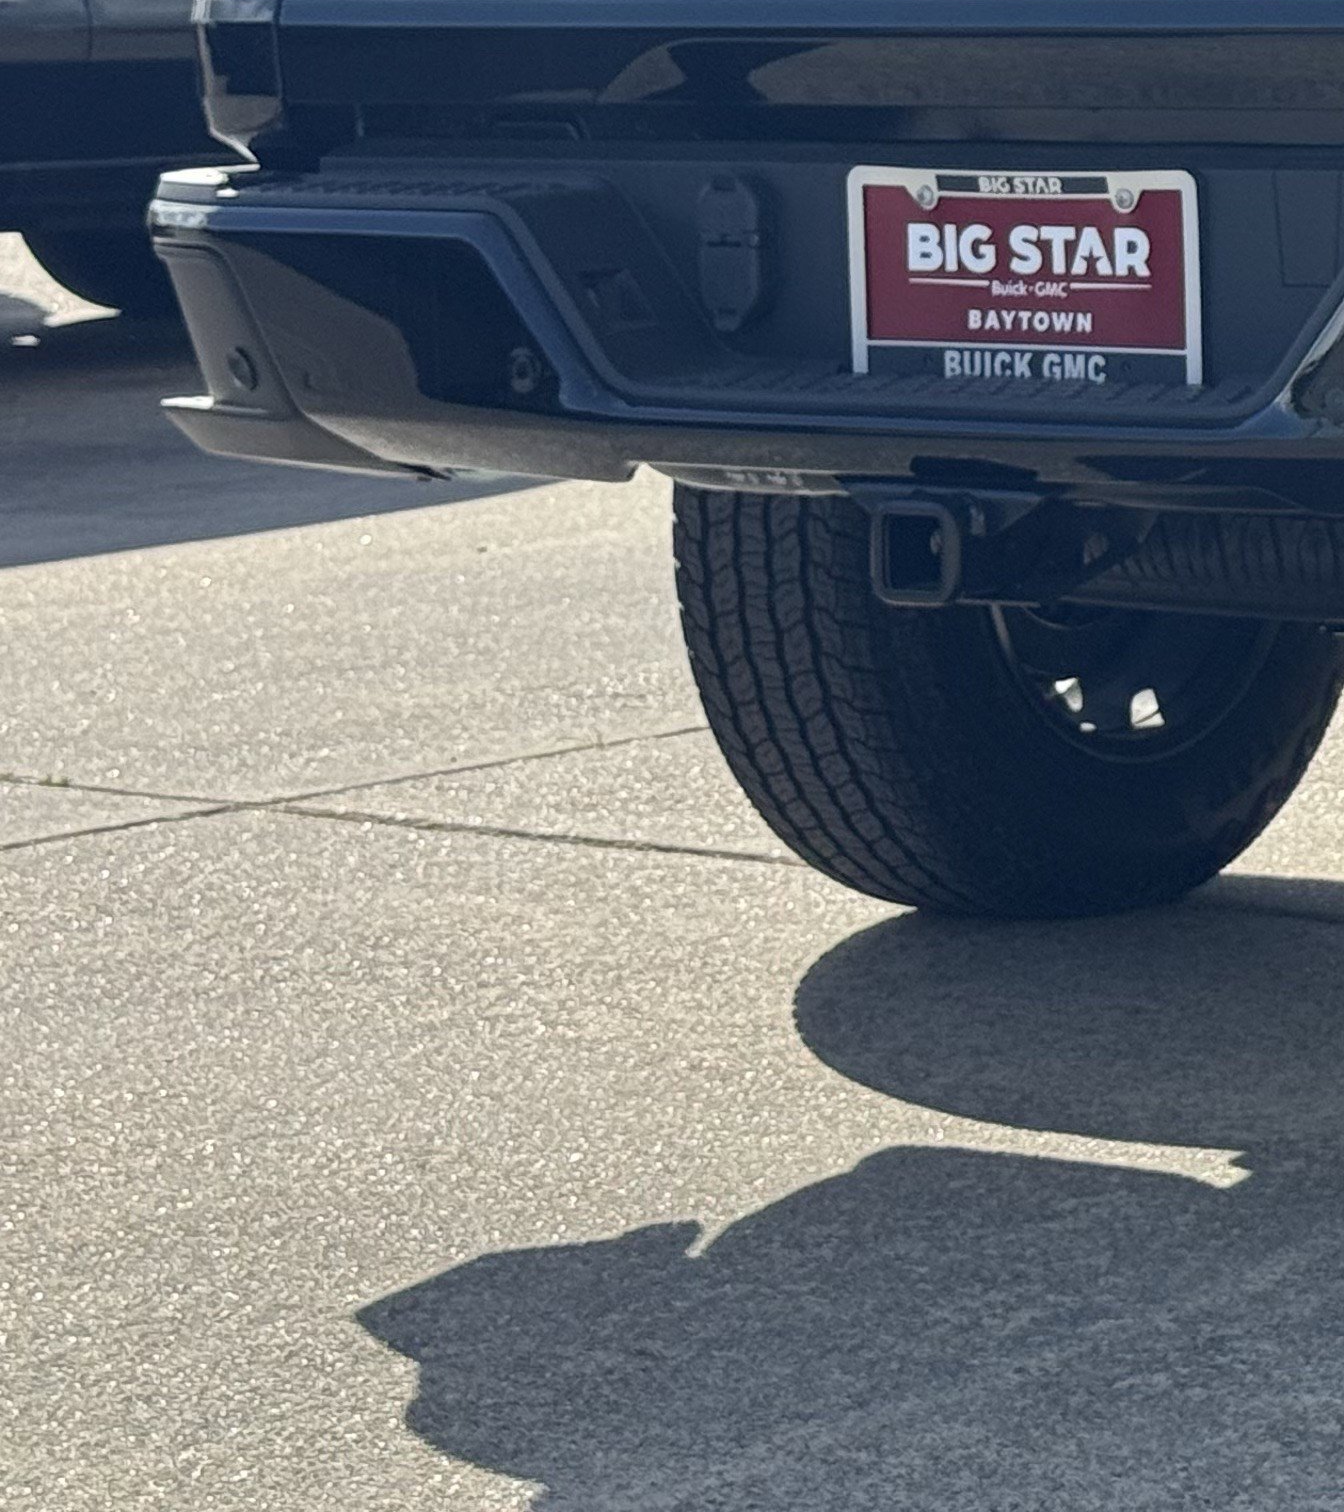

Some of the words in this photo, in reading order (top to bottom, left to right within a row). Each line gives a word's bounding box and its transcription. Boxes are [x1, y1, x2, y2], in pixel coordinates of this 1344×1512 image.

[978, 176, 1009, 193] BIG
[1014, 177, 1063, 194] STAR
[906, 222, 996, 274] BIG
[1008, 224, 1151, 277] STAR
[967, 309, 1092, 333] BAYTOWN
[944, 350, 1032, 379] BUICK
[1042, 354, 1106, 384] GMC
